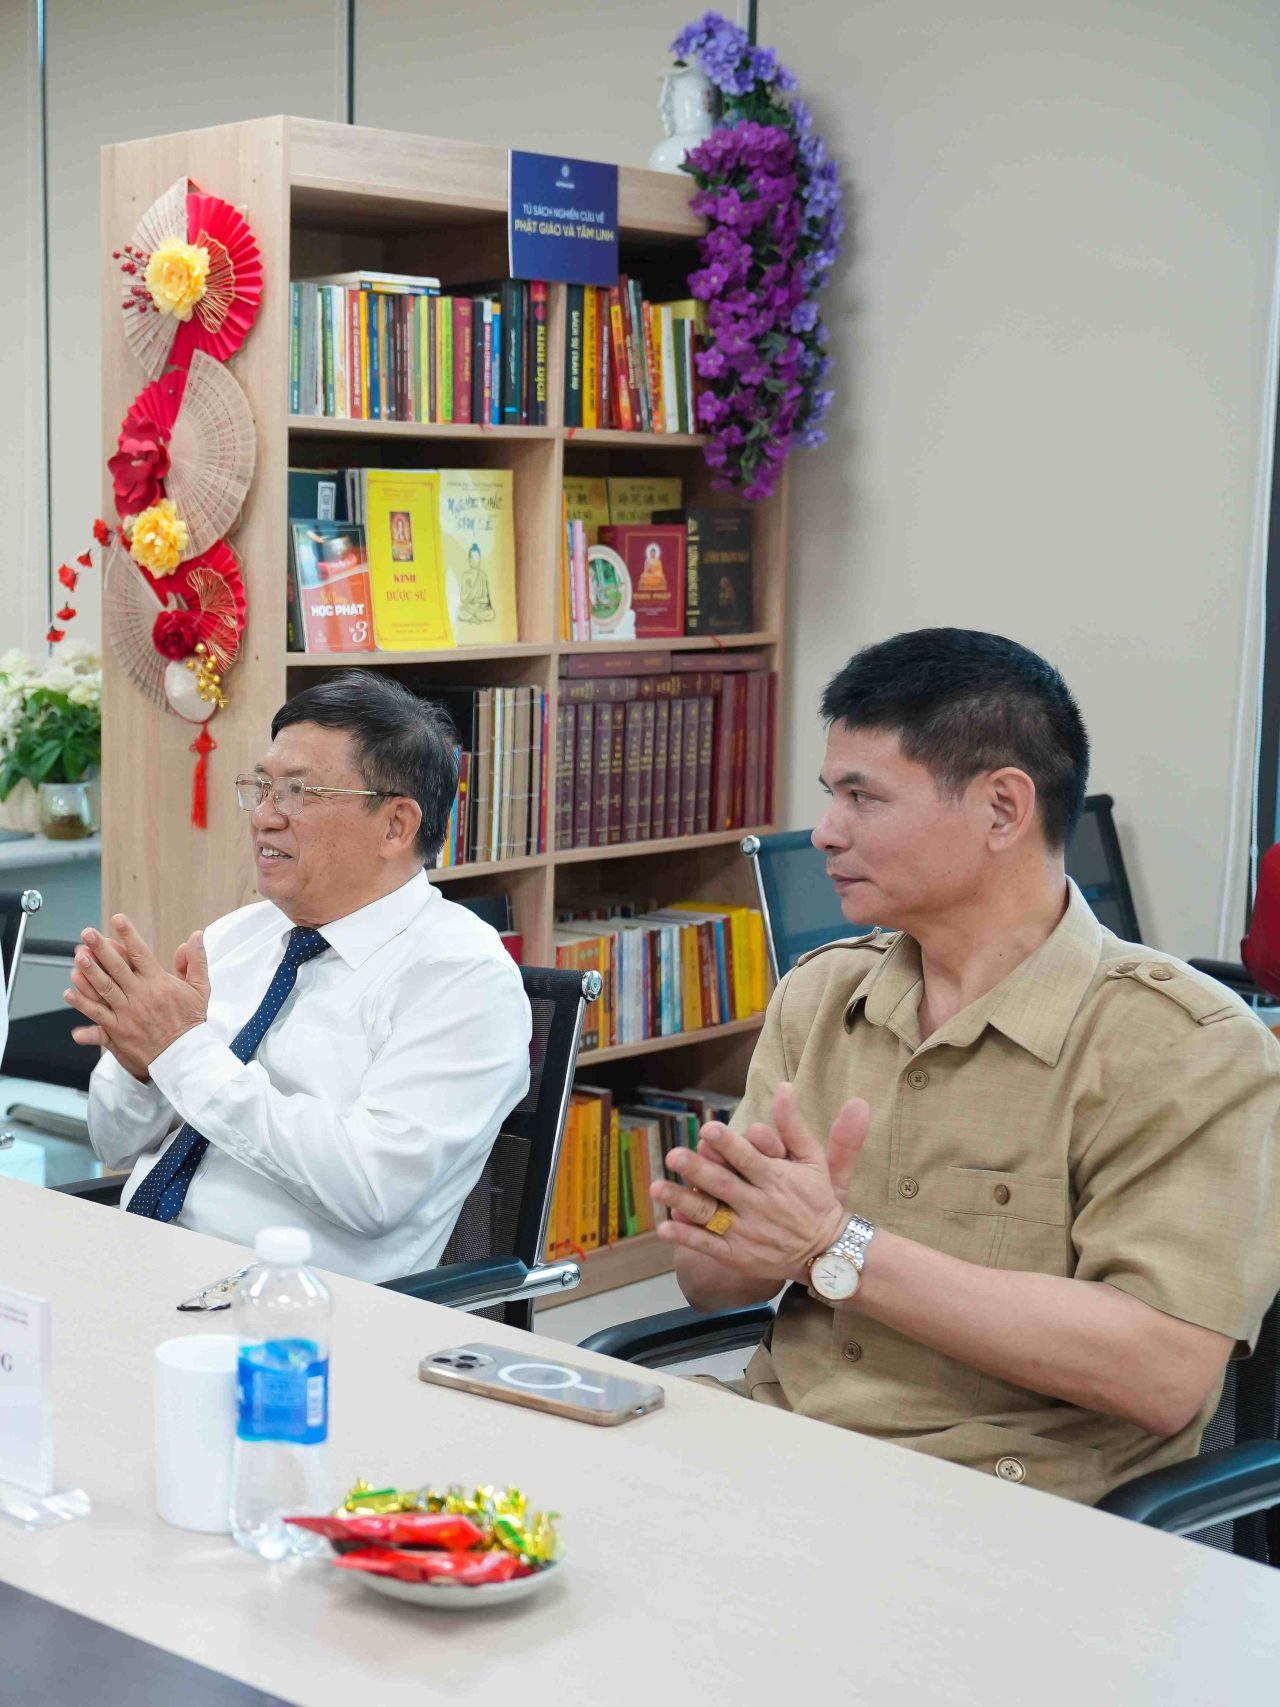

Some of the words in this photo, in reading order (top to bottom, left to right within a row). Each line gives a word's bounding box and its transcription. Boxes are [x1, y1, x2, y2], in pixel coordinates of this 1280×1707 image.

[533, 204, 553, 217] SÁCH
[553, 206, 579, 220] NGHIÊN
[515, 218, 538, 236] PHẬT
[539, 220, 561, 237] GIÁO
[563, 223, 575, 238] VÀ
[576, 225, 594, 239] TÂM
[595, 228, 615, 242] LINH
[394, 573, 417, 584] KINH
[311, 604, 334, 618] HỌC
[335, 602, 366, 618] PHẬT
[351, 619, 369, 643] 3
